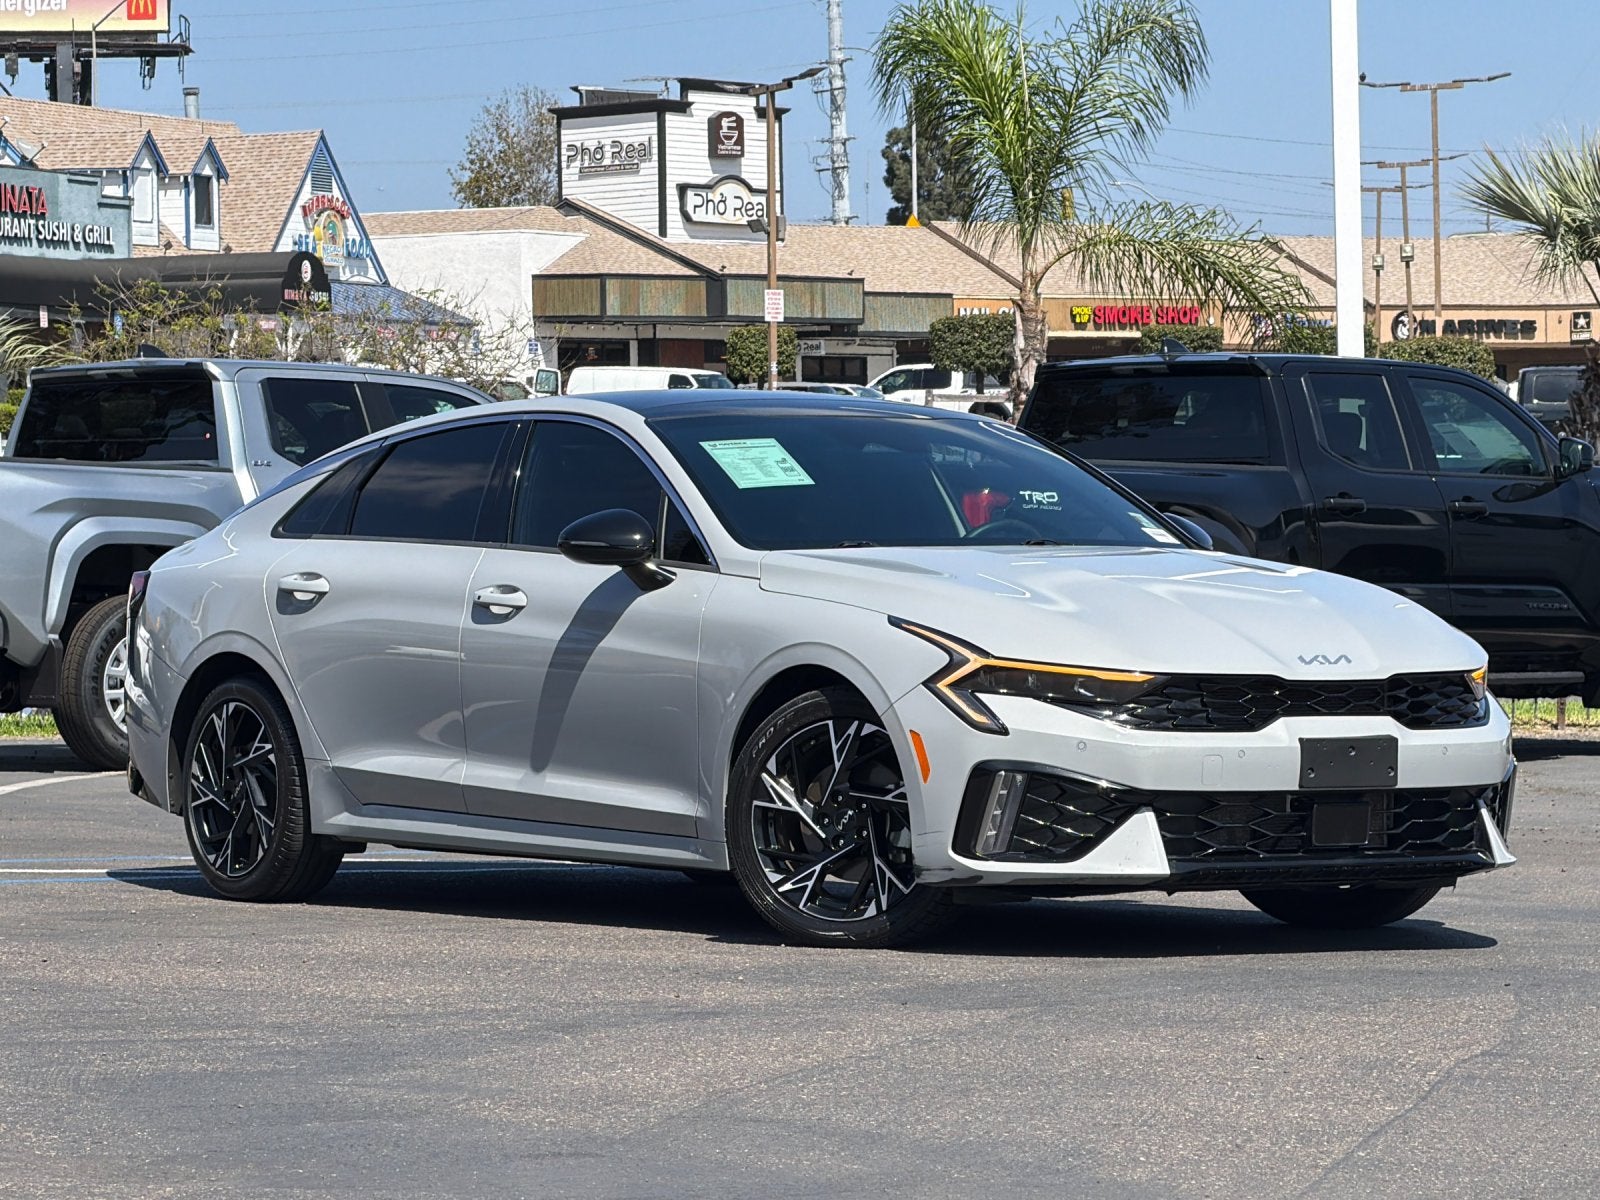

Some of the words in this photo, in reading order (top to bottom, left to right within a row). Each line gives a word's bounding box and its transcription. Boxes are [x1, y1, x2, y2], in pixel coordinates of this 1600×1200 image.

[611, 136, 652, 161] Real
[38, 221, 71, 242] SUSHI
[73, 224, 83, 243] &
[85, 224, 115, 246] GRILL
[344, 238, 371, 258] FOOD
[1071, 306, 1093, 315] SMOKE
[1094, 305, 1153, 325] SMOKE
[1157, 305, 1201, 325] SHOP
